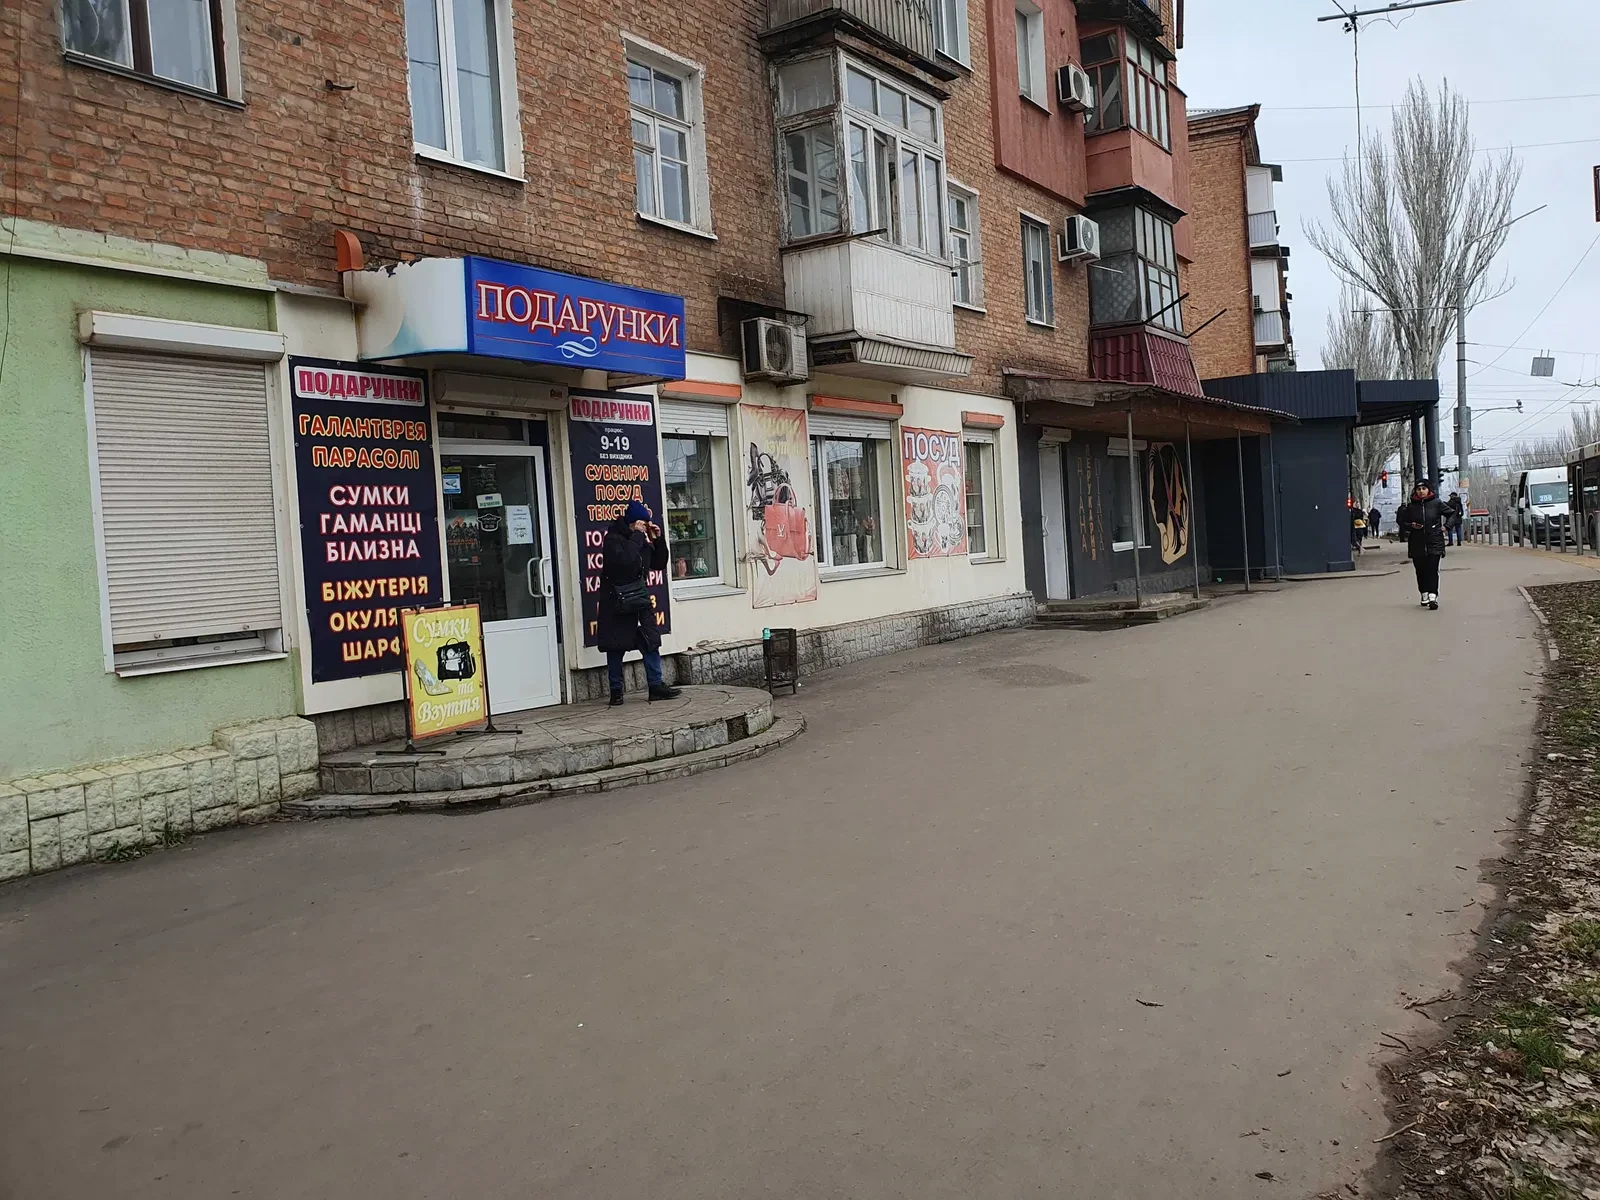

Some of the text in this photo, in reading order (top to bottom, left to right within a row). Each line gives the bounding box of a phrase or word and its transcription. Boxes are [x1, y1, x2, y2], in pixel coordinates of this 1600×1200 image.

[476, 281, 680, 347] ПОДАРУНКИ
[299, 370, 422, 402] ПОДАРУНКИ
[571, 399, 651, 422] ПОДАРУНКИ
[299, 414, 427, 441] ГАЛАНТЕРЕЯ
[600, 435, 630, 451] 9-19
[903, 431, 960, 467] ПОСУД
[312, 446, 420, 469] ПАРАСОЛІ
[585, 464, 648, 481] СУВЕНІРИ
[330, 485, 409, 506] СУМКИ
[595, 484, 643, 503] ПОСУД
[319, 511, 422, 534] ГАМАНЦІ
[587, 503, 653, 521] ТЕКСТ
[326, 539, 421, 562] БІЛИЗНА
[322, 576, 429, 602] БІЖУТЕРІЯ
[329, 606, 425, 632] ОКУЛЯ
[413, 617, 471, 648] Сумки
[418, 697, 481, 727] Взуття
